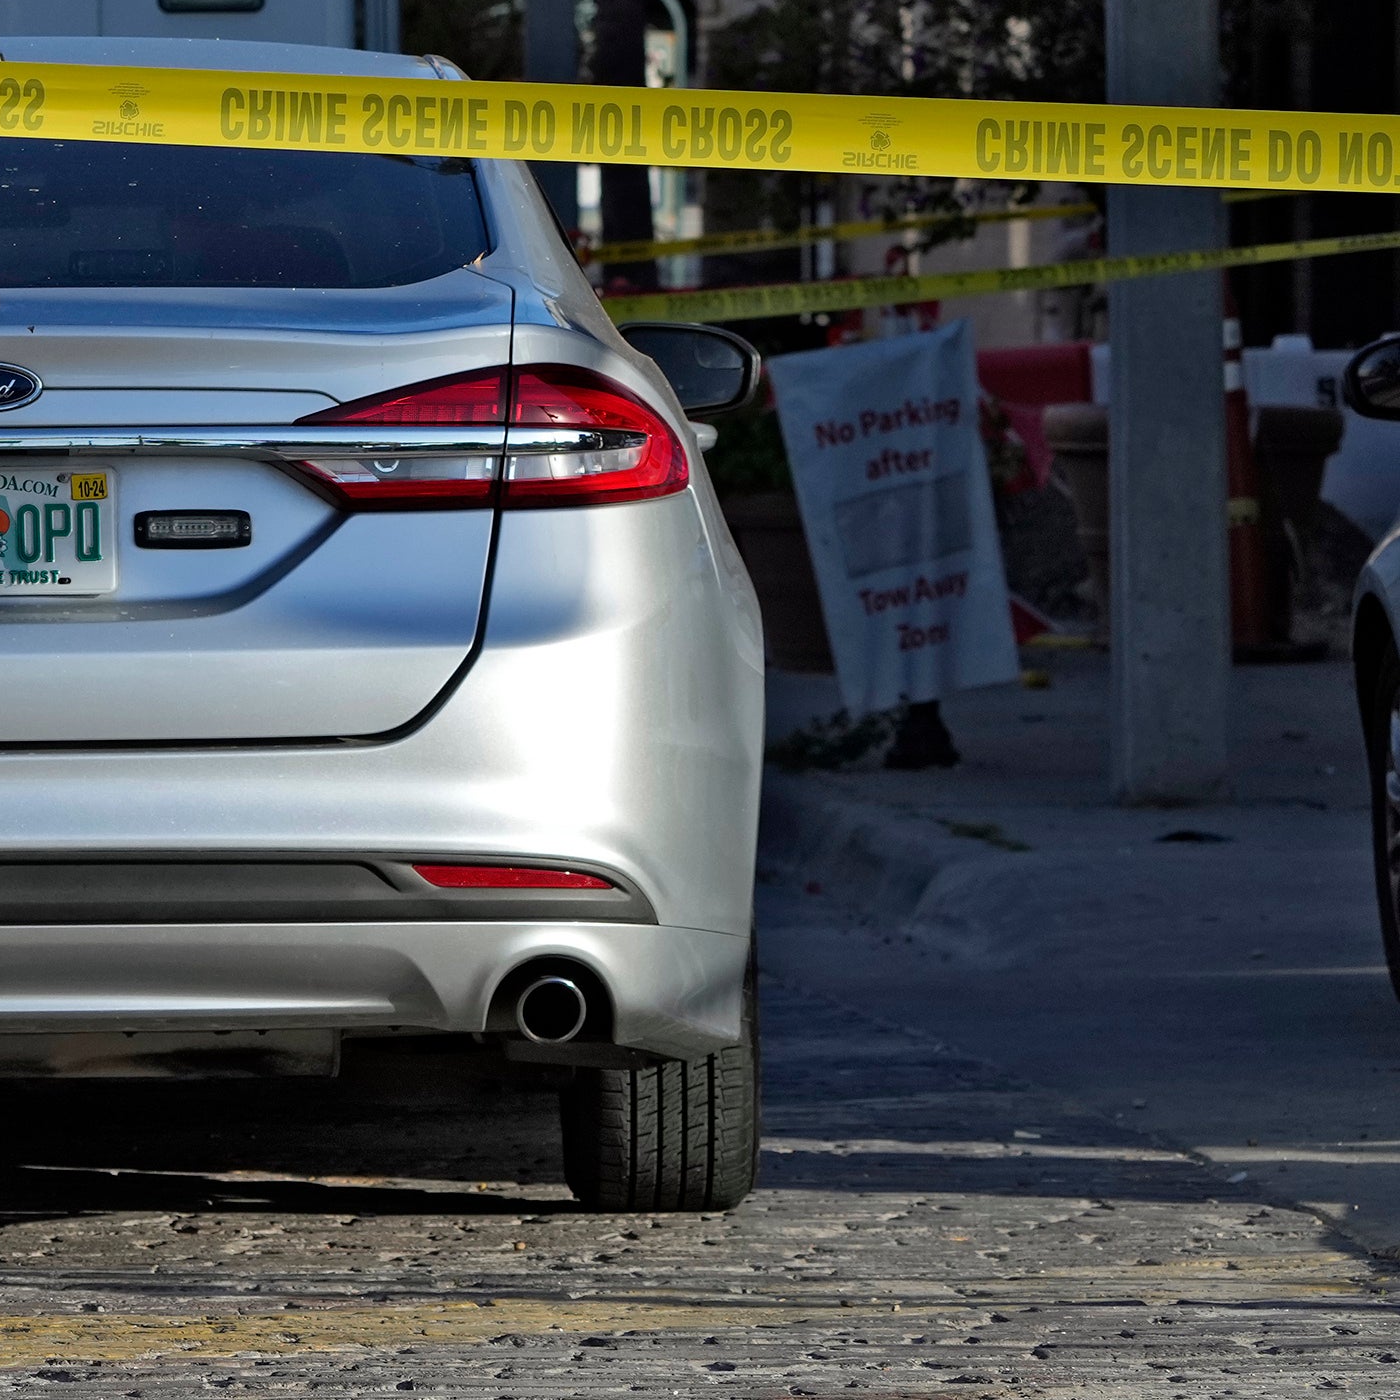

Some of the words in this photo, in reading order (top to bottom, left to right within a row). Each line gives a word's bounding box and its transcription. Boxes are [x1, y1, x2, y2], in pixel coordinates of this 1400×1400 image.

[814, 421, 856, 450] No
[858, 397, 961, 438] Parking
[866, 447, 933, 481] after
[77, 479, 106, 497] 10-24
[9, 569, 60, 585] TRUST
[858, 586, 909, 616] Tow
